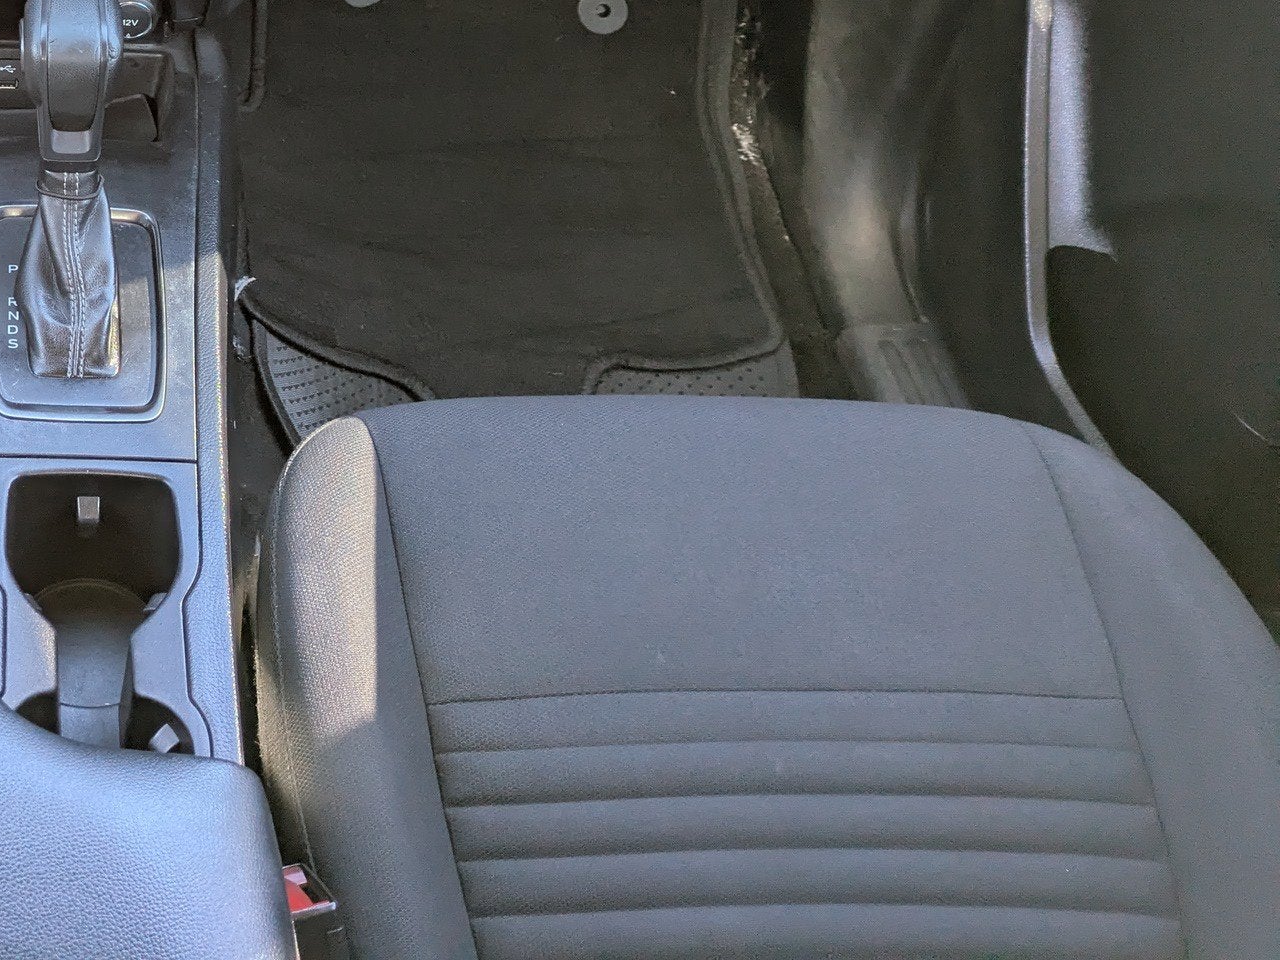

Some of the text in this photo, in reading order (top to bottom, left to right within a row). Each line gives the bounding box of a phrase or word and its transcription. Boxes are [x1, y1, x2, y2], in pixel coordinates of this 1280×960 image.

[122, 19, 139, 27] 12V
[8, 264, 19, 274] P
[8, 311, 20, 321] N
[7, 325, 19, 335] D
[7, 339, 19, 349] S
